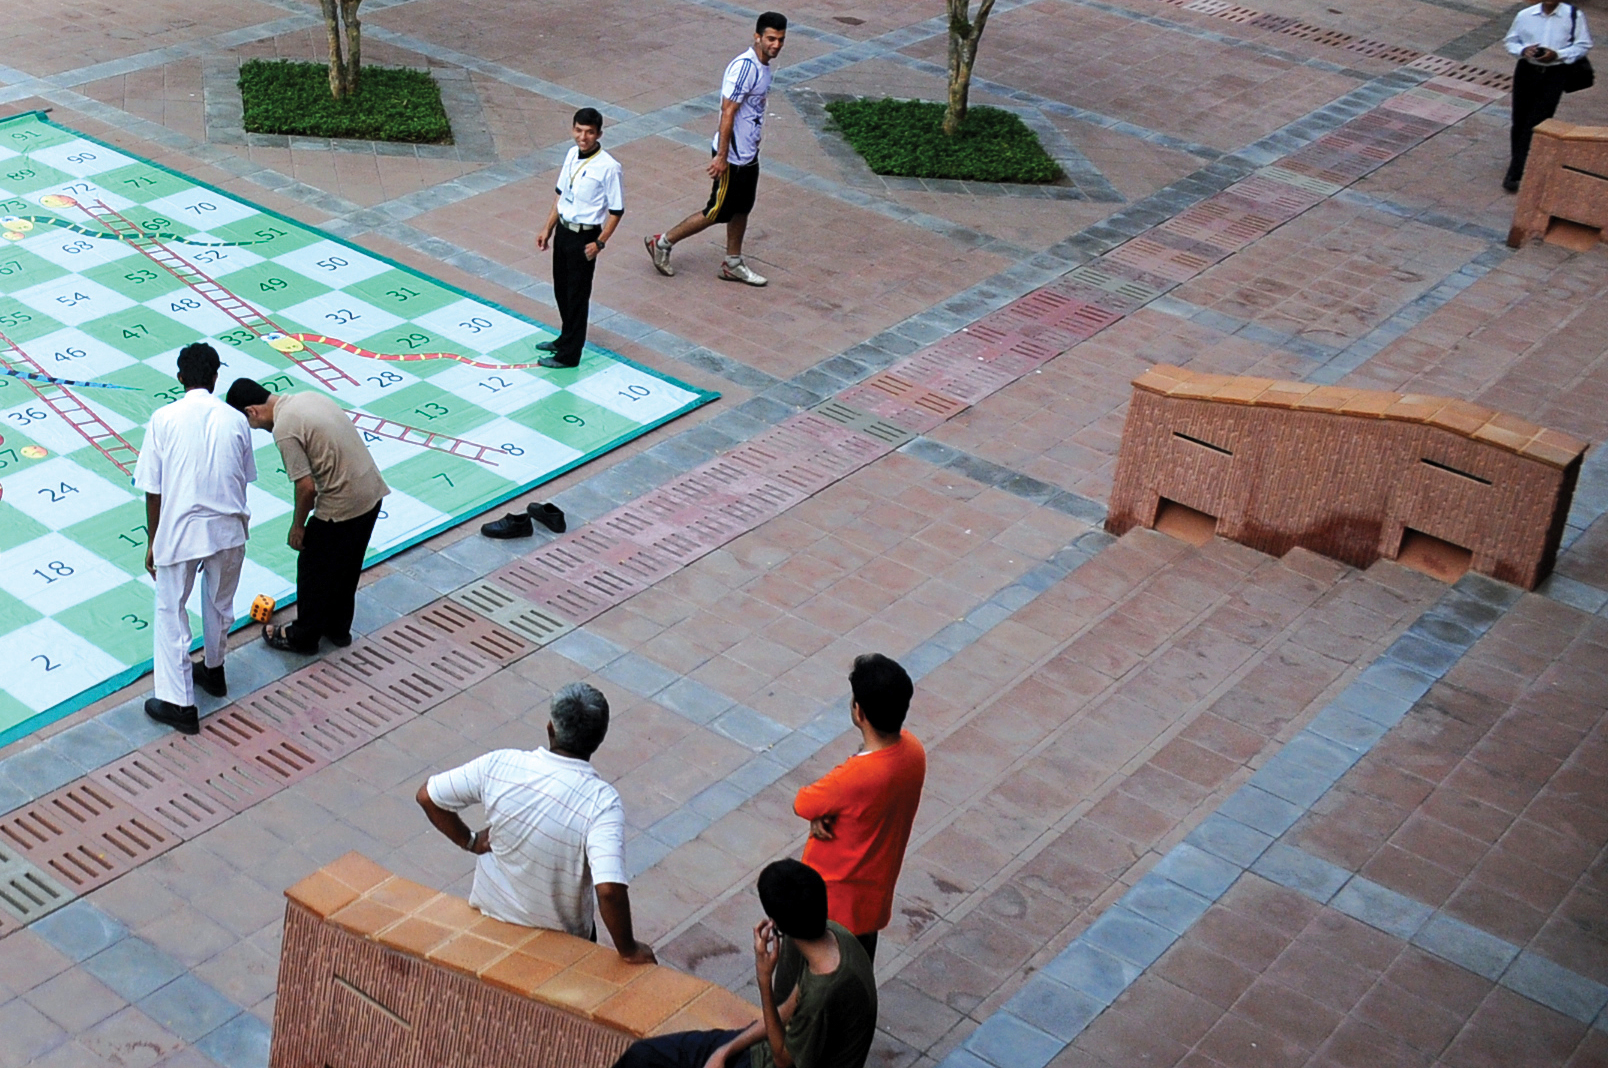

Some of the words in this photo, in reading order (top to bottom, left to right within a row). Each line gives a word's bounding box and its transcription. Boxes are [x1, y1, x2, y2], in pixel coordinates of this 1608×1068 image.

[12, 131, 41, 141] 91
[67, 153, 96, 163] 90
[7, 169, 35, 180] 89
[62, 183, 96, 194] 72
[124, 177, 157, 188] 71
[185, 203, 216, 214] 70
[142, 218, 171, 230] 69
[254, 227, 288, 240] 51
[62, 241, 93, 253] 68
[193, 250, 227, 263] 52
[316, 257, 348, 271] 50
[124, 270, 157, 283] 53
[260, 278, 287, 291] 49
[56, 292, 90, 306] 54
[386, 288, 420, 301] 31
[171, 299, 200, 312] 48
[325, 309, 361, 324] 32
[123, 324, 148, 339] 47
[459, 318, 492, 333] 30
[219, 330, 254, 346] 33
[396, 334, 430, 348] 29
[55, 348, 86, 361] 46
[261, 375, 294, 393] 27
[367, 372, 402, 387] 28
[479, 377, 513, 393] 12
[619, 385, 650, 401] 10
[9, 408, 47, 425] 36
[415, 403, 448, 420] 13
[563, 415, 585, 427] 9
[362, 431, 383, 449] 4
[501, 443, 524, 456] 8
[432, 473, 454, 487] 7
[38, 482, 79, 502] 24
[119, 525, 149, 548] 17
[33, 561, 74, 583] 18
[122, 614, 148, 630] 3
[31, 655, 61, 671] 2
